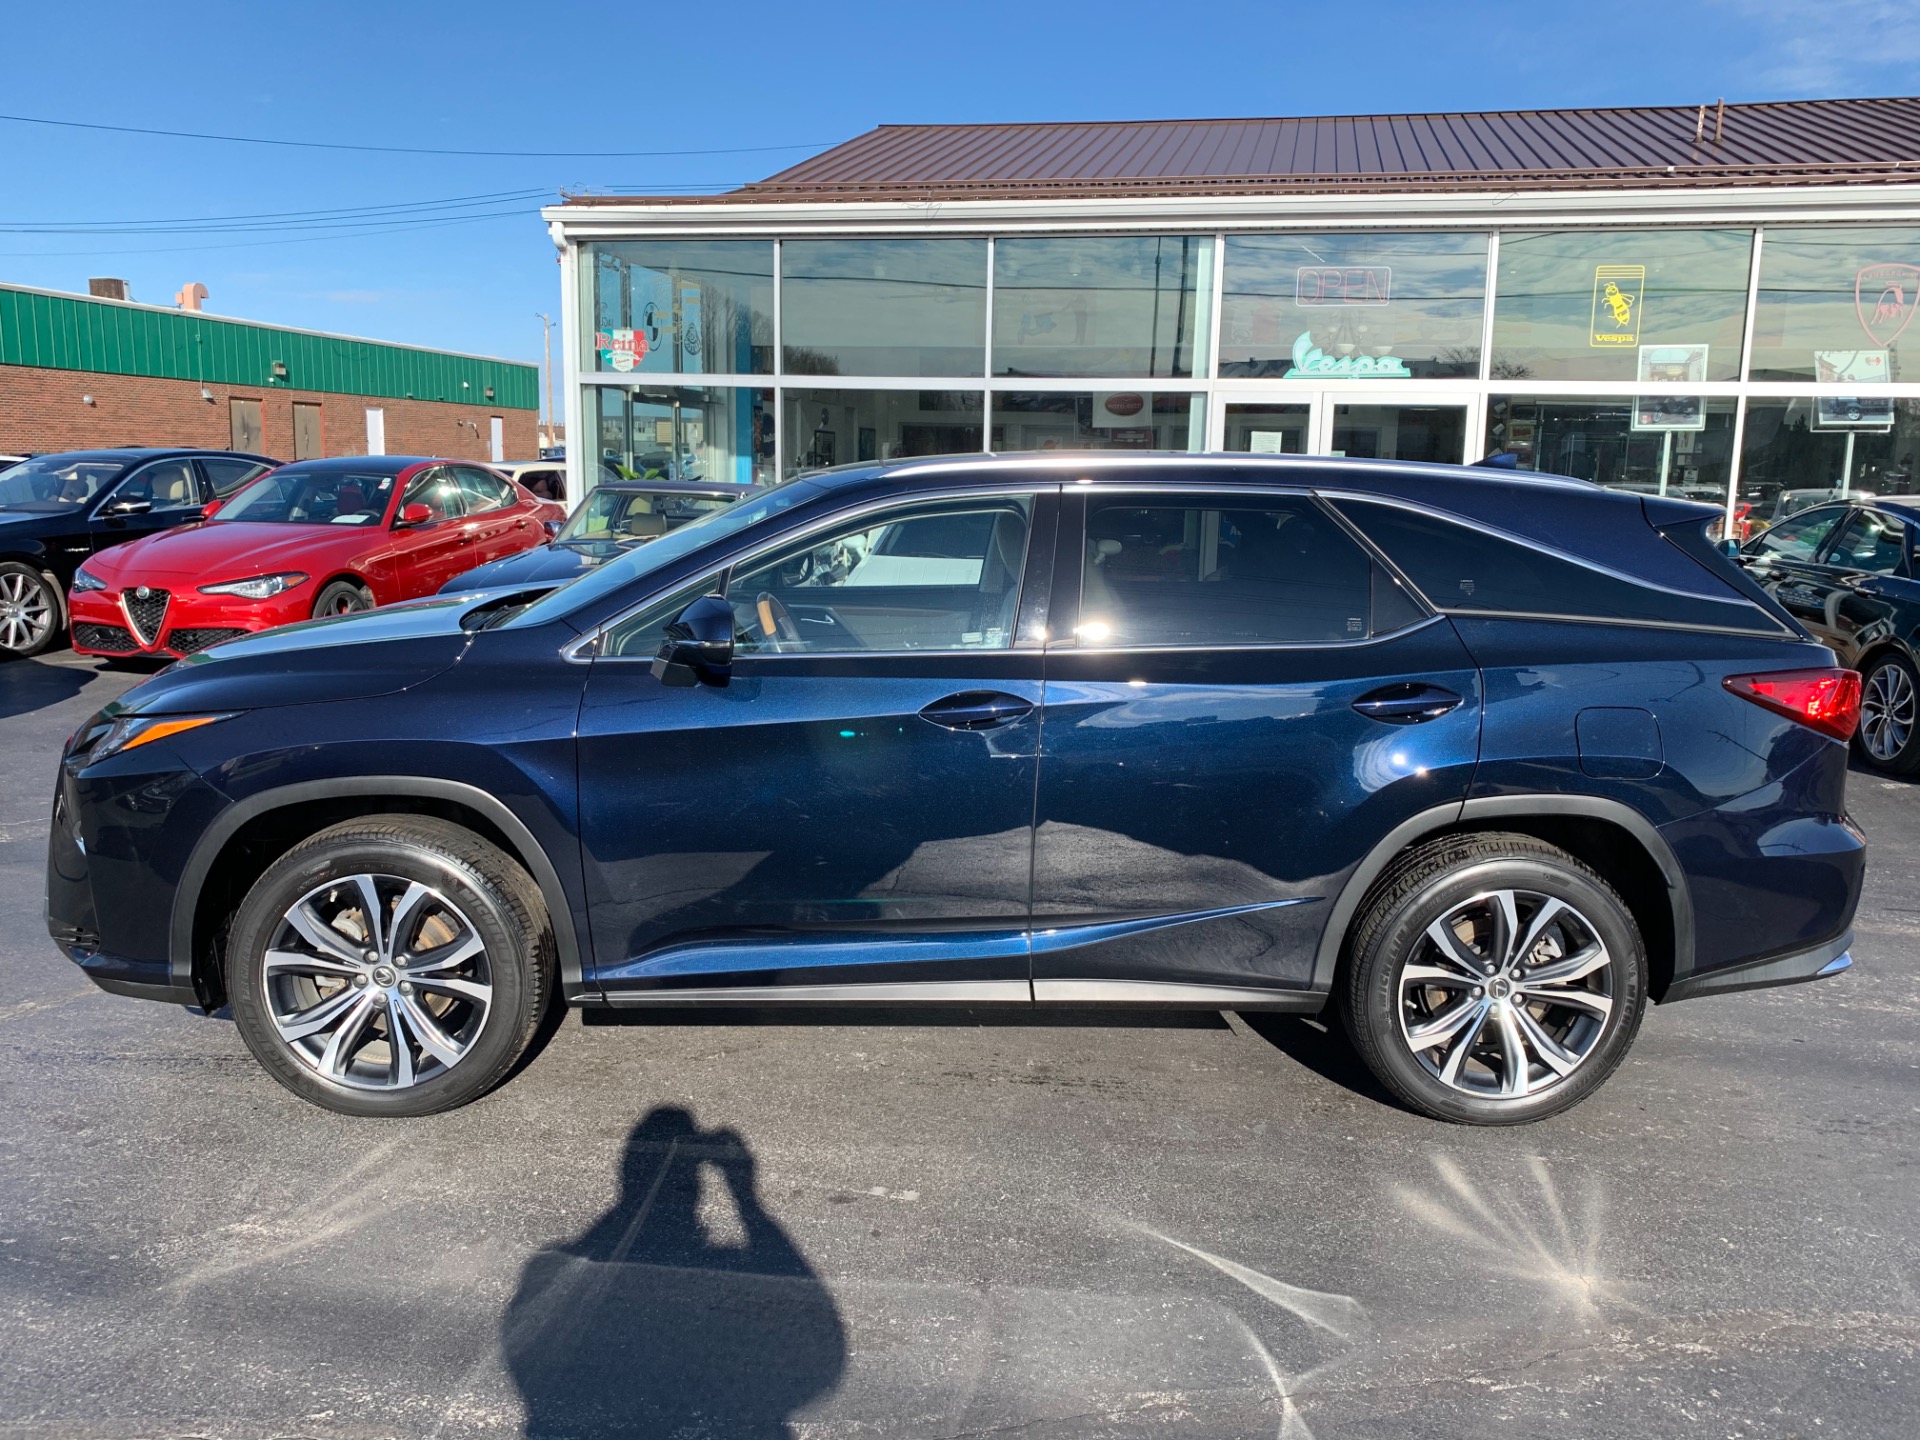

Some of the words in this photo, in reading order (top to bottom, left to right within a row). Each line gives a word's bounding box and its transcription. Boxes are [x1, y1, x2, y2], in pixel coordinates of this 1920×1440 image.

[1300, 270, 1388, 303] OPEN
[595, 332, 650, 352] Reina
[1291, 330, 1406, 378] Vespa
[1594, 334, 1635, 344] Vespa
[457, 885, 512, 963] MICHELIN
[1377, 927, 1408, 1008] MICHELIN
